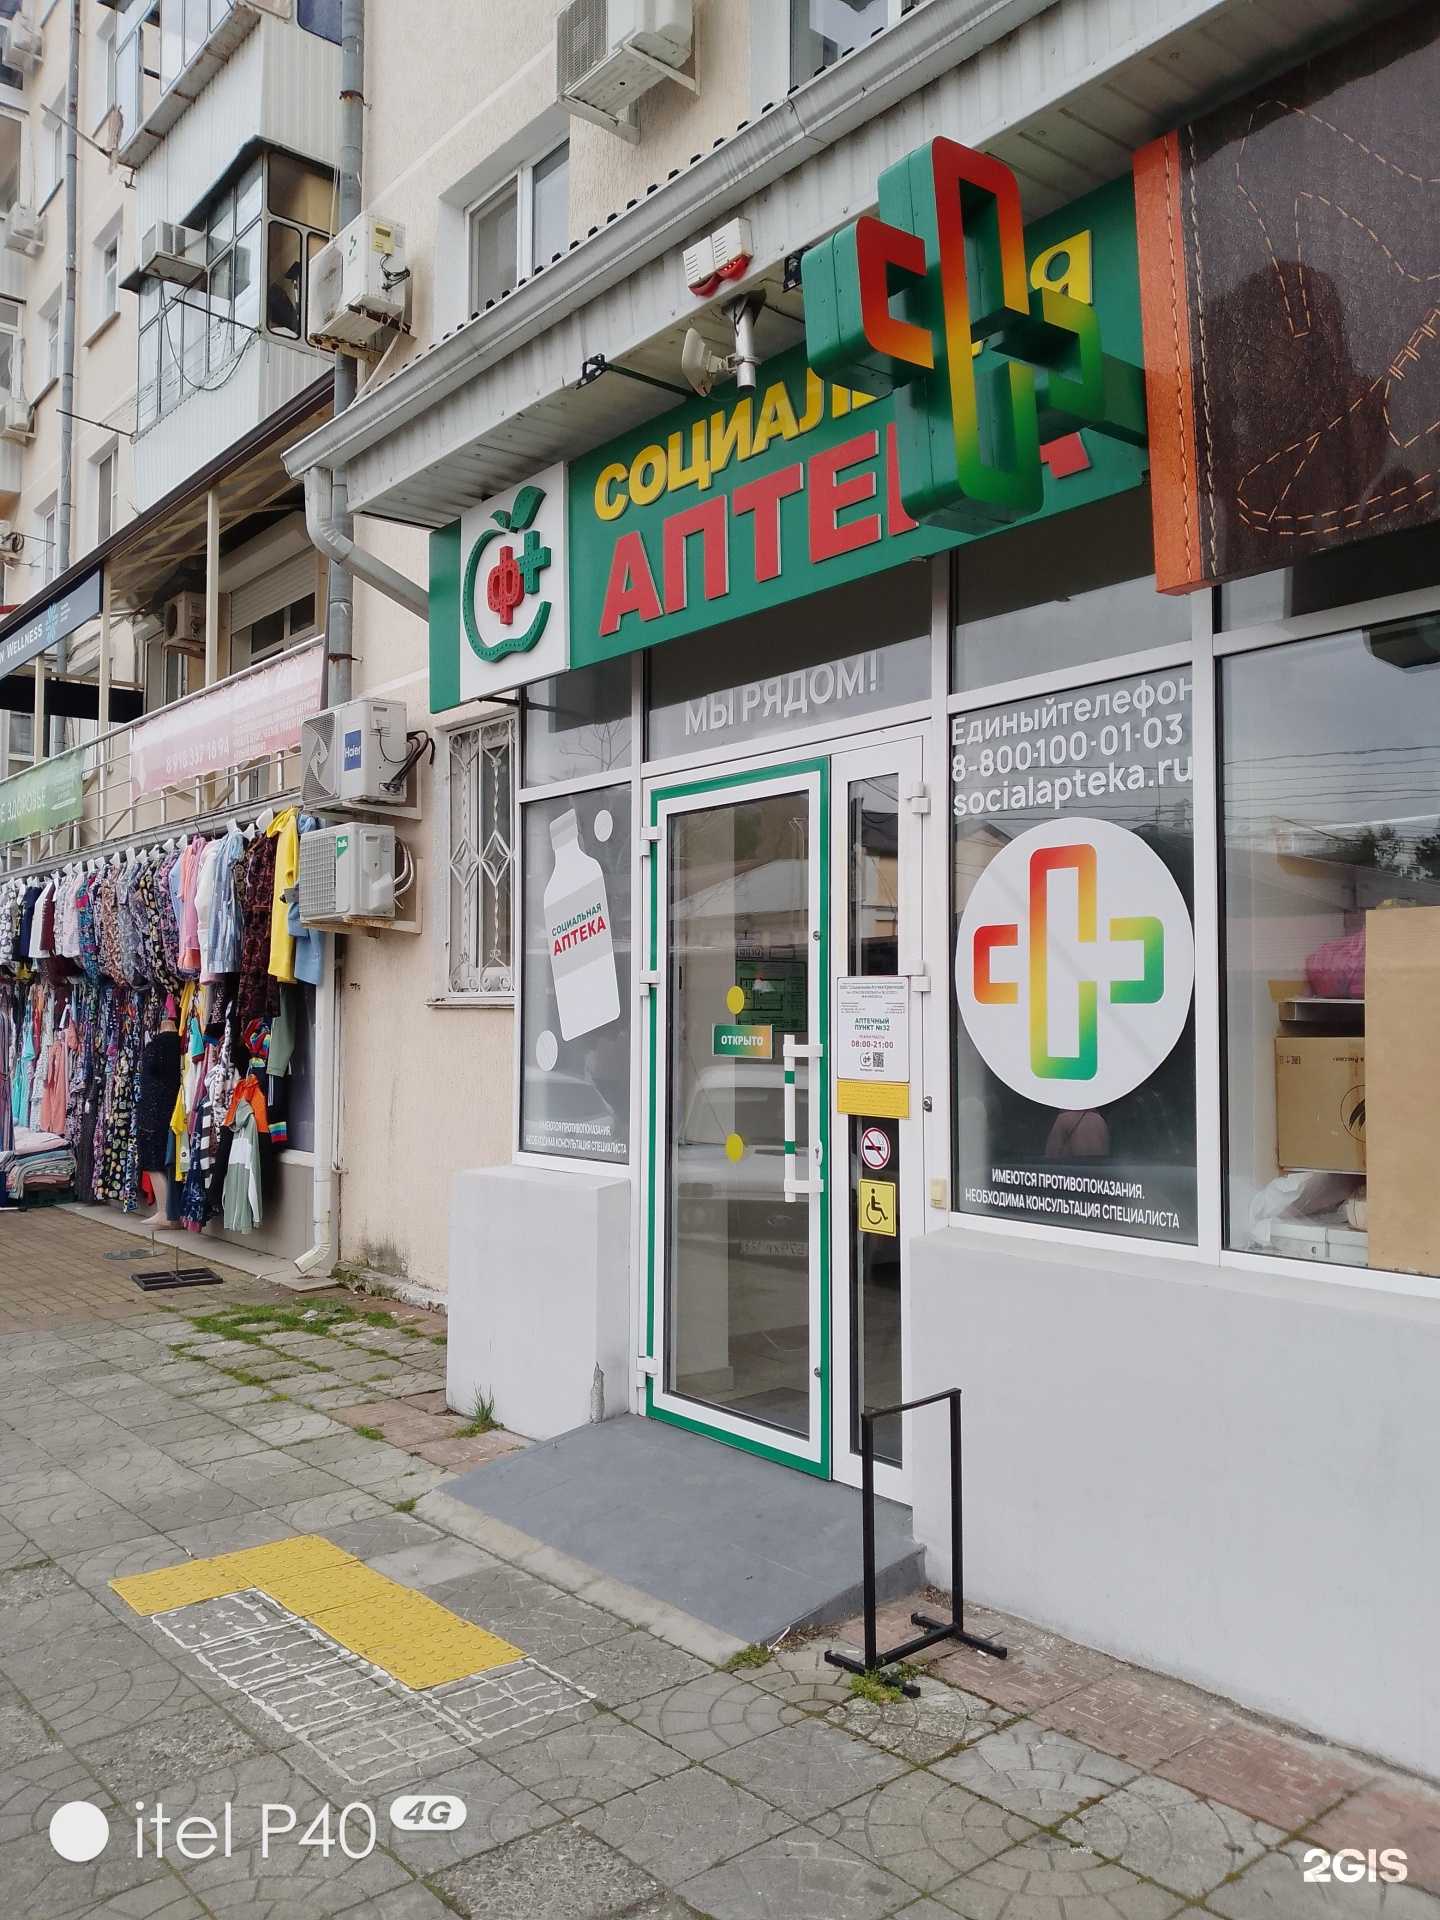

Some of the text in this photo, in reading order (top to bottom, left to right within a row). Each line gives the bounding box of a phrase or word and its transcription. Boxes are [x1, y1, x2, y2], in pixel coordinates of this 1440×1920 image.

[594, 229, 1093, 521] СОЦИАЛЯ
[599, 423, 1092, 637] АПТЕ
[6, 623, 43, 658] WELLNESS
[685, 649, 878, 736] МЫ РЯДОМ!
[344, 744, 361, 758] Haier
[953, 756, 1193, 816] socialapteka.ru
[551, 902, 602, 937] СОЦИАЛЬНАЯ
[553, 915, 607, 957] АПТЕКА
[854, 1017, 890, 1025] АПТЕЧНЫЙ
[721, 1035, 764, 1047] ОТКРЫТО
[991, 1167, 1146, 1200] ИМЕЮТСЯ ПРОТИВОПОКАЗАНИЯ.
[965, 1188, 1180, 1229] НЕОБХОДИМА КОНСУЛЬТАЦИЯ СПЕЦИАЛИСТА
